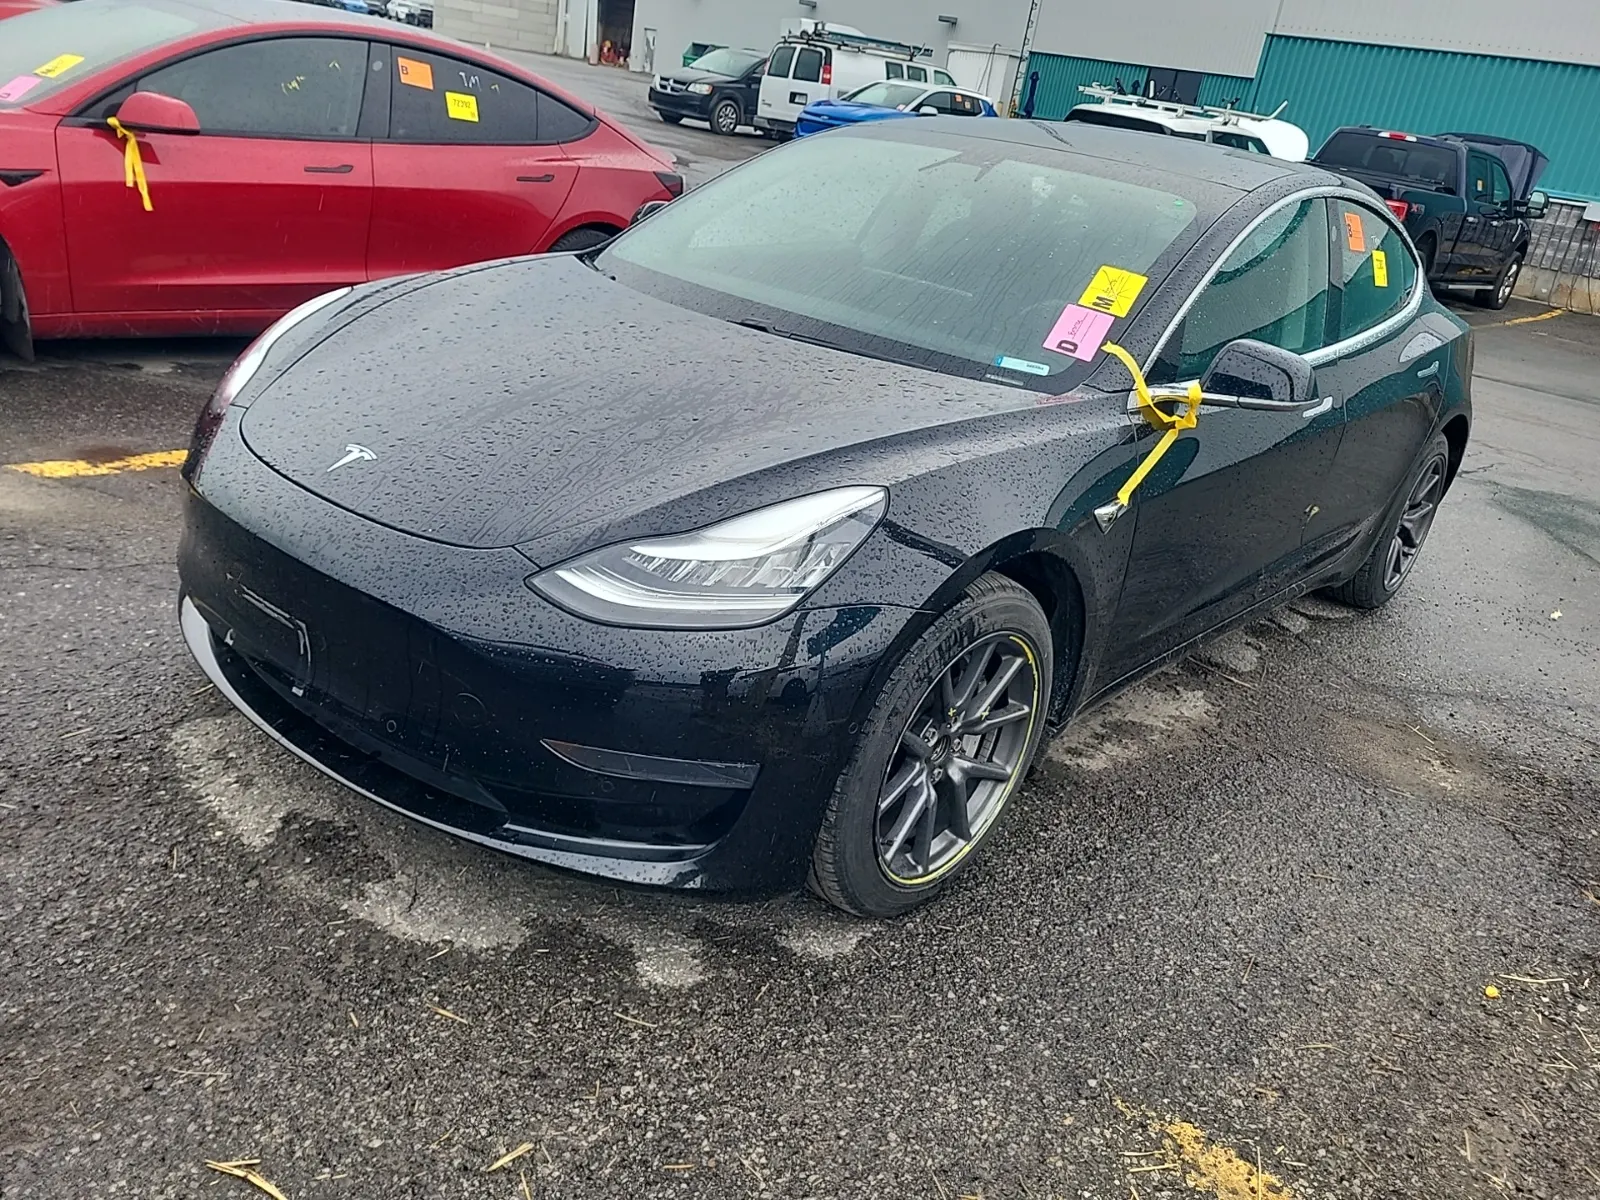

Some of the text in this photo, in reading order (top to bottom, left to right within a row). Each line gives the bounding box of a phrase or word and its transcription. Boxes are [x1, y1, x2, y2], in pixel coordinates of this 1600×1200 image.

[401, 65, 409, 75] B
[1092, 296, 1115, 310] M
[1056, 339, 1079, 354] D
